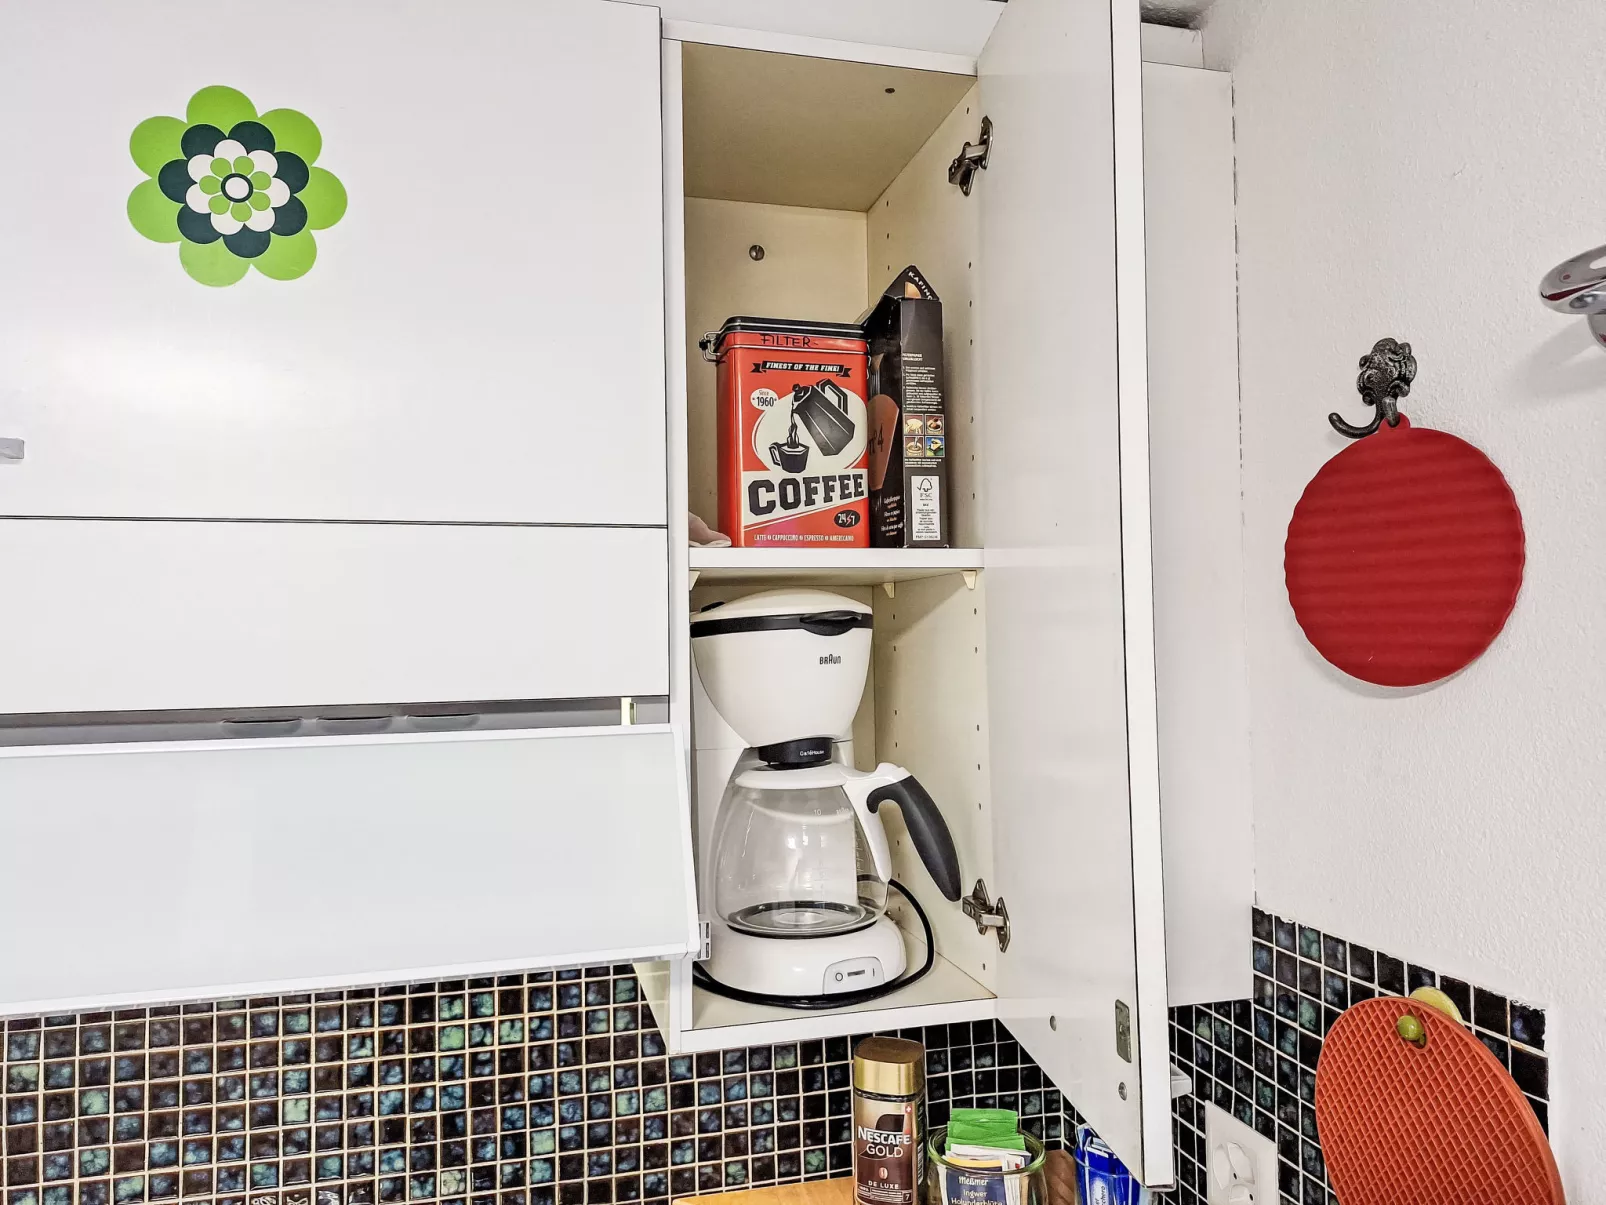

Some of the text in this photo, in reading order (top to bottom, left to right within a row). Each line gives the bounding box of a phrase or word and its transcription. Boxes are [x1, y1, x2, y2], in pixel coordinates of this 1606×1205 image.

[760, 334, 811, 348] FILTER
[766, 362, 792, 370] FINEST
[805, 364, 819, 372] THE
[756, 397, 775, 407] 1960
[748, 474, 865, 516] COFFEE
[814, 808, 822, 816] 10
[866, 1143, 904, 1158] GOLD
[958, 1175, 988, 1186] Meßmer
[963, 1189, 987, 1198] Ingwer
